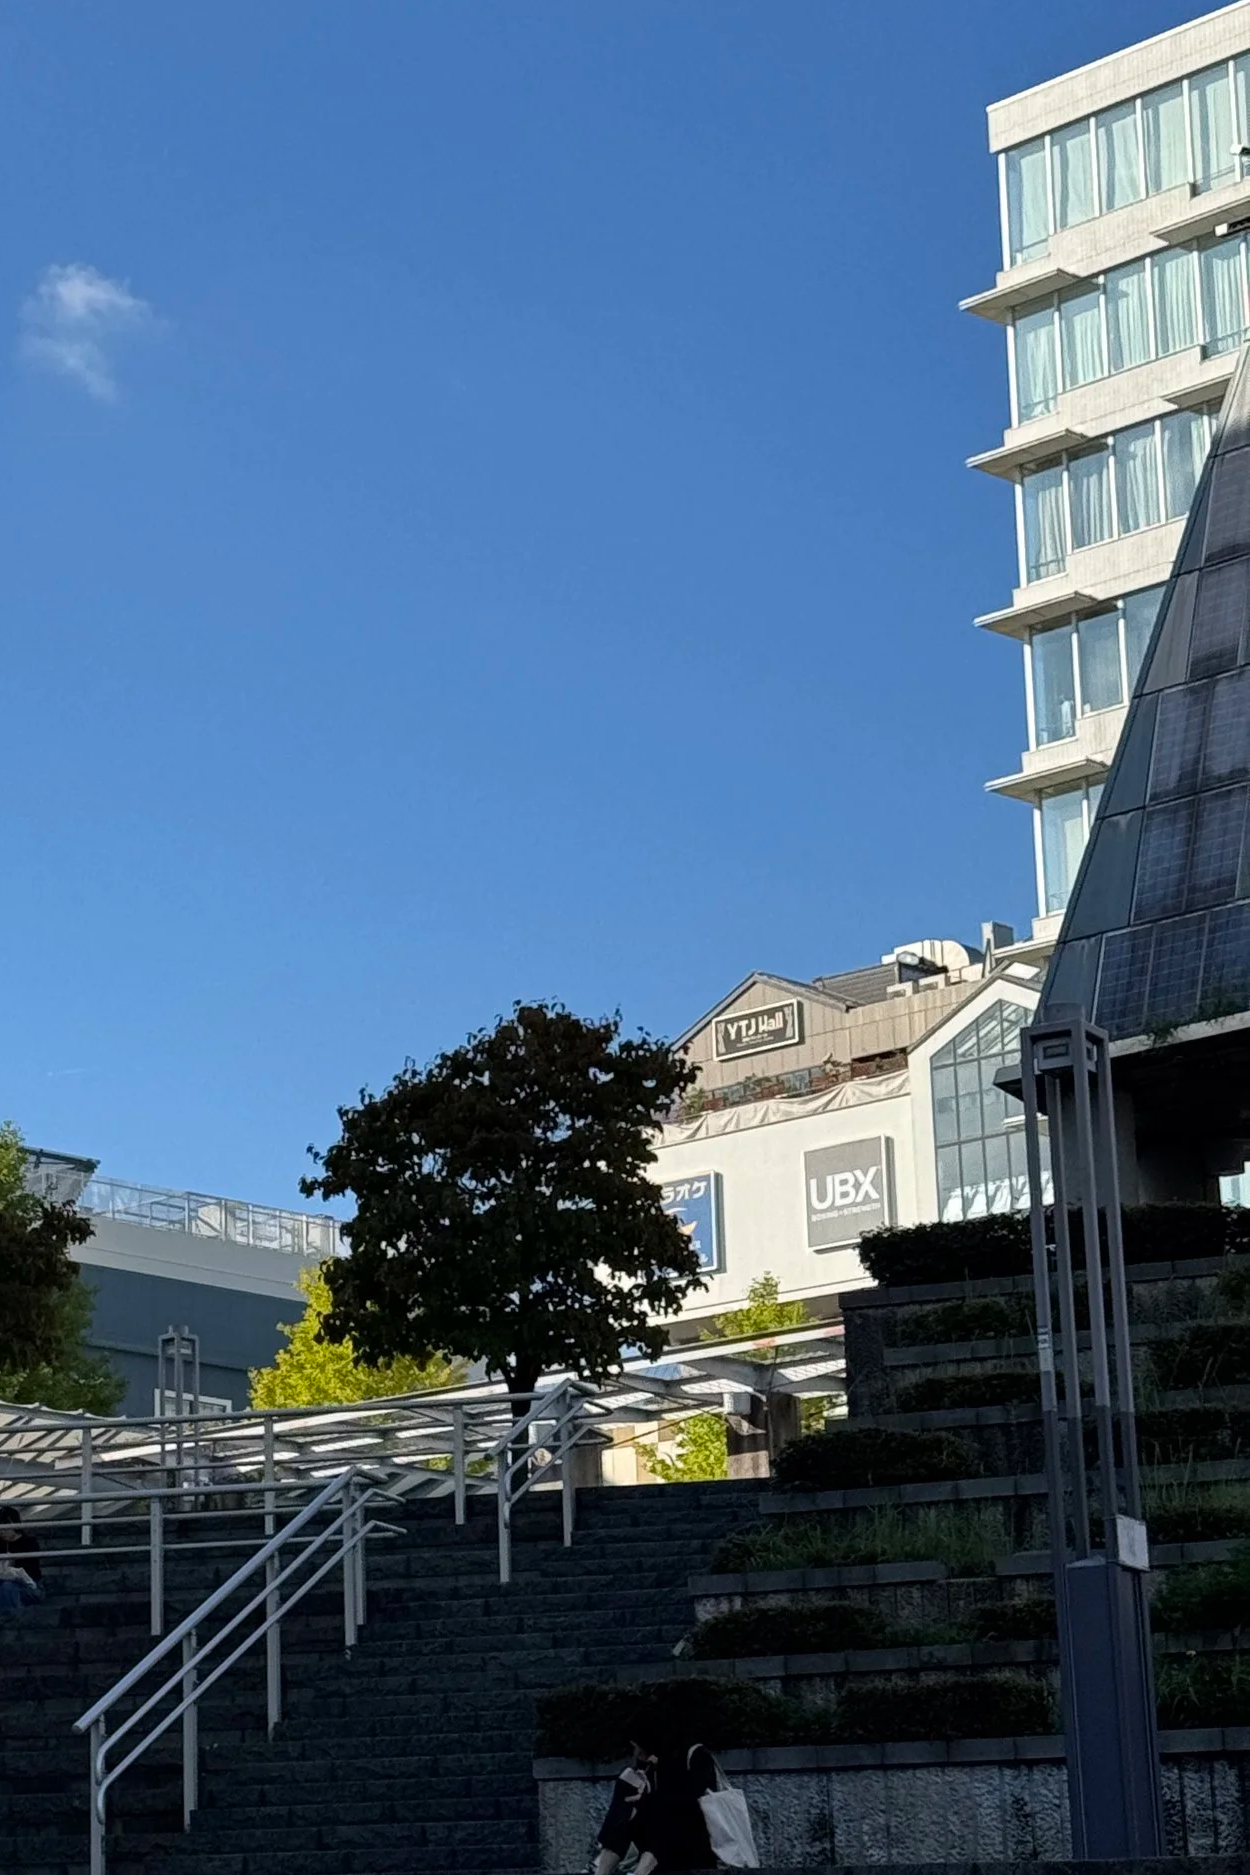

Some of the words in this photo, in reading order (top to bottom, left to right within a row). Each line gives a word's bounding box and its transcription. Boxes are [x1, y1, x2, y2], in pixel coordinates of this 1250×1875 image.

[726, 1017, 756, 1041] YTJ
[757, 1011, 784, 1034] Hall
[660, 1181, 708, 1205] ラオケ
[809, 1165, 881, 1210] UBX
